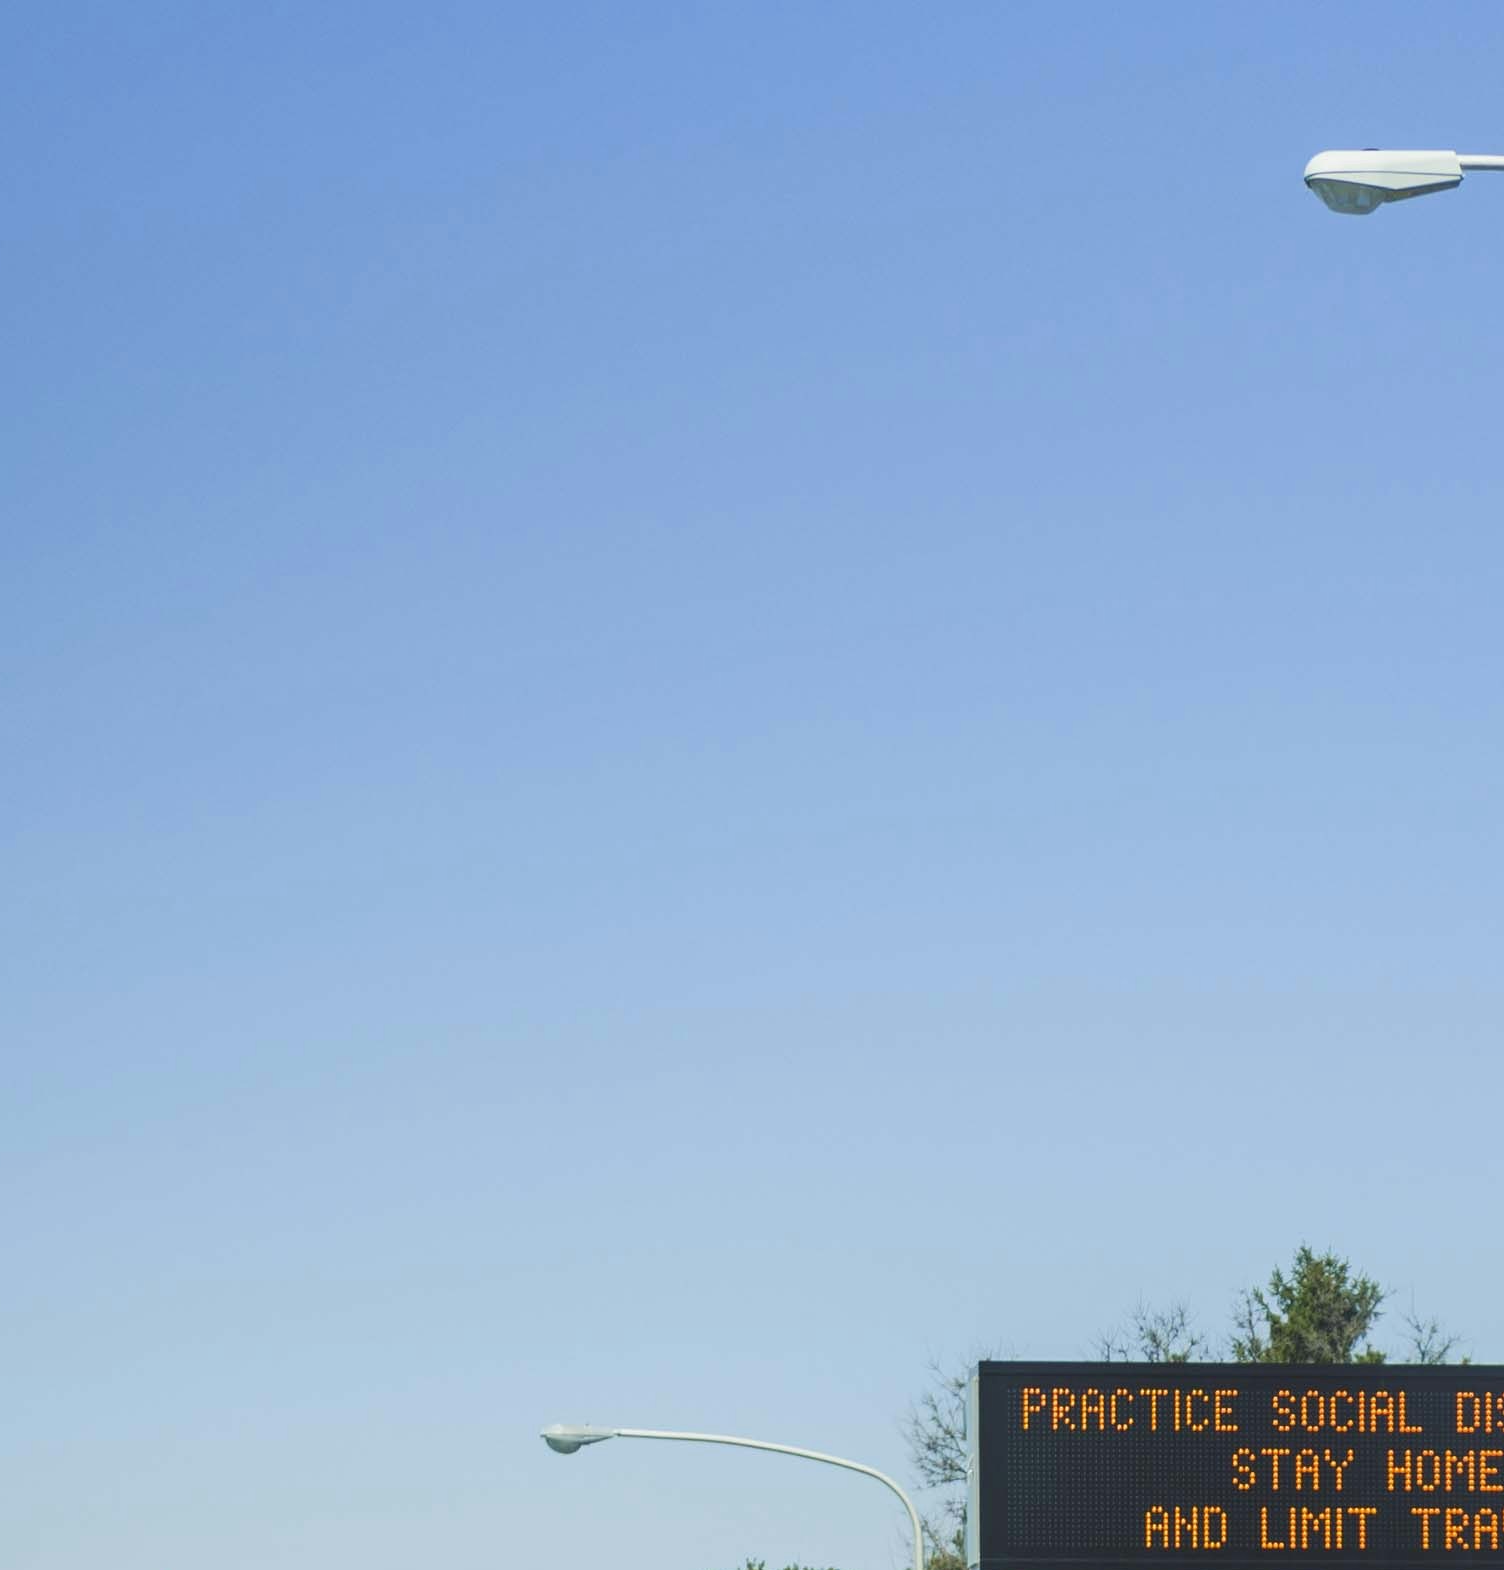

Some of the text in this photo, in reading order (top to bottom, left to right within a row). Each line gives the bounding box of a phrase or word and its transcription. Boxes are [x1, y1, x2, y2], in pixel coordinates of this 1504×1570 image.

[1023, 1387, 1238, 1432] PRACTICE
[1272, 1389, 1423, 1433] SOCIAL
[1232, 1448, 1504, 1492] STAY HOME
[1145, 1506, 1227, 1549] AND
[1261, 1506, 1377, 1549] LIMIT
